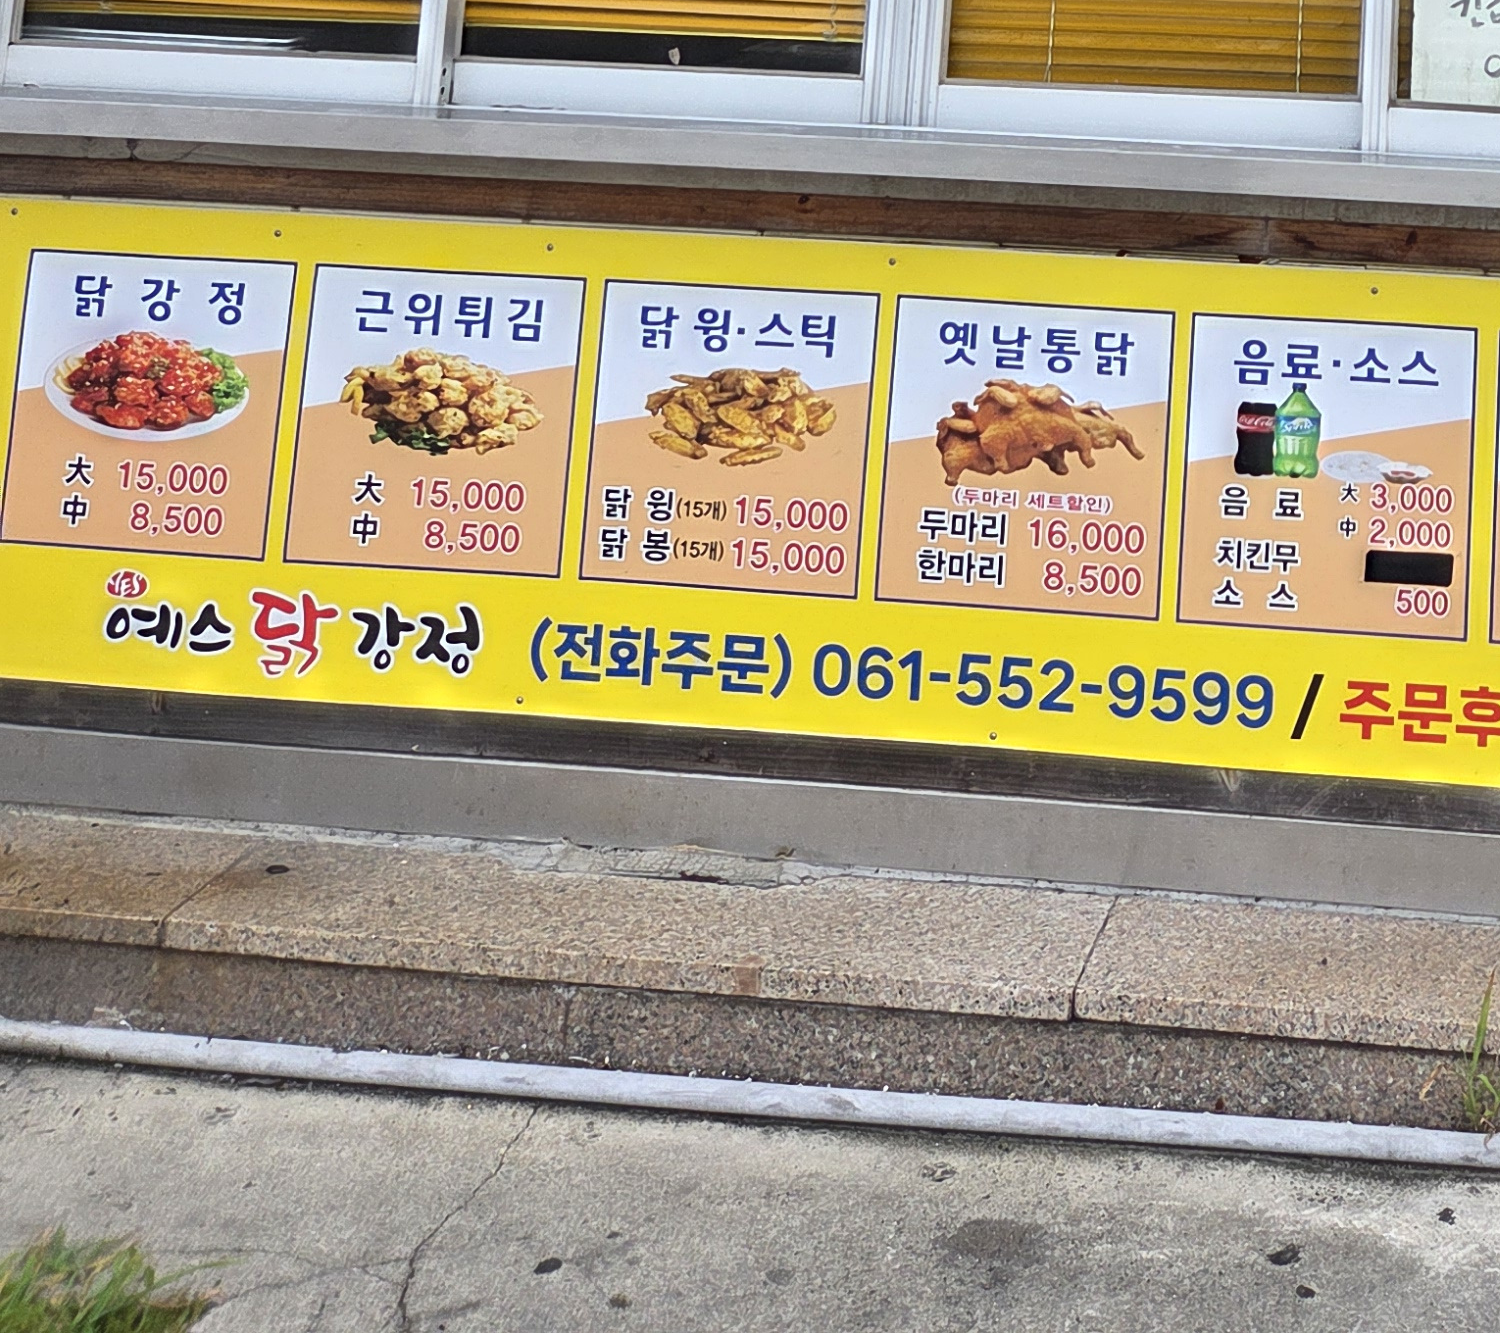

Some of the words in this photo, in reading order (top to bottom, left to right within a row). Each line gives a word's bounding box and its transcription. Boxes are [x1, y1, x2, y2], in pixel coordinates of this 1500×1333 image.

[66, 456, 94, 486] 大
[119, 461, 228, 496] 15,000
[354, 474, 383, 504] 大
[412, 479, 525, 512] 15,000
[62, 495, 88, 526] 中
[130, 502, 224, 536] 8,500
[736, 497, 848, 532] 15,000
[1340, 483, 1359, 504] 大
[1371, 483, 1453, 514] 3,000
[353, 513, 378, 545] 中
[424, 520, 520, 554] 8,500
[919, 509, 1007, 546] 두마리
[1028, 518, 1145, 555] 16,000
[1339, 517, 1357, 538] 中
[1369, 518, 1452, 549] 2,000
[732, 539, 845, 575] 15,000
[918, 548, 1004, 586] 한마리
[1043, 561, 1142, 597] 8,500
[1217, 539, 1299, 573] 치킨무
[106, 571, 147, 597] YES
[1396, 589, 1449, 616] 500
[531, 617, 793, 699] (전화주문)
[811, 642, 1275, 729] 061-552-9599
